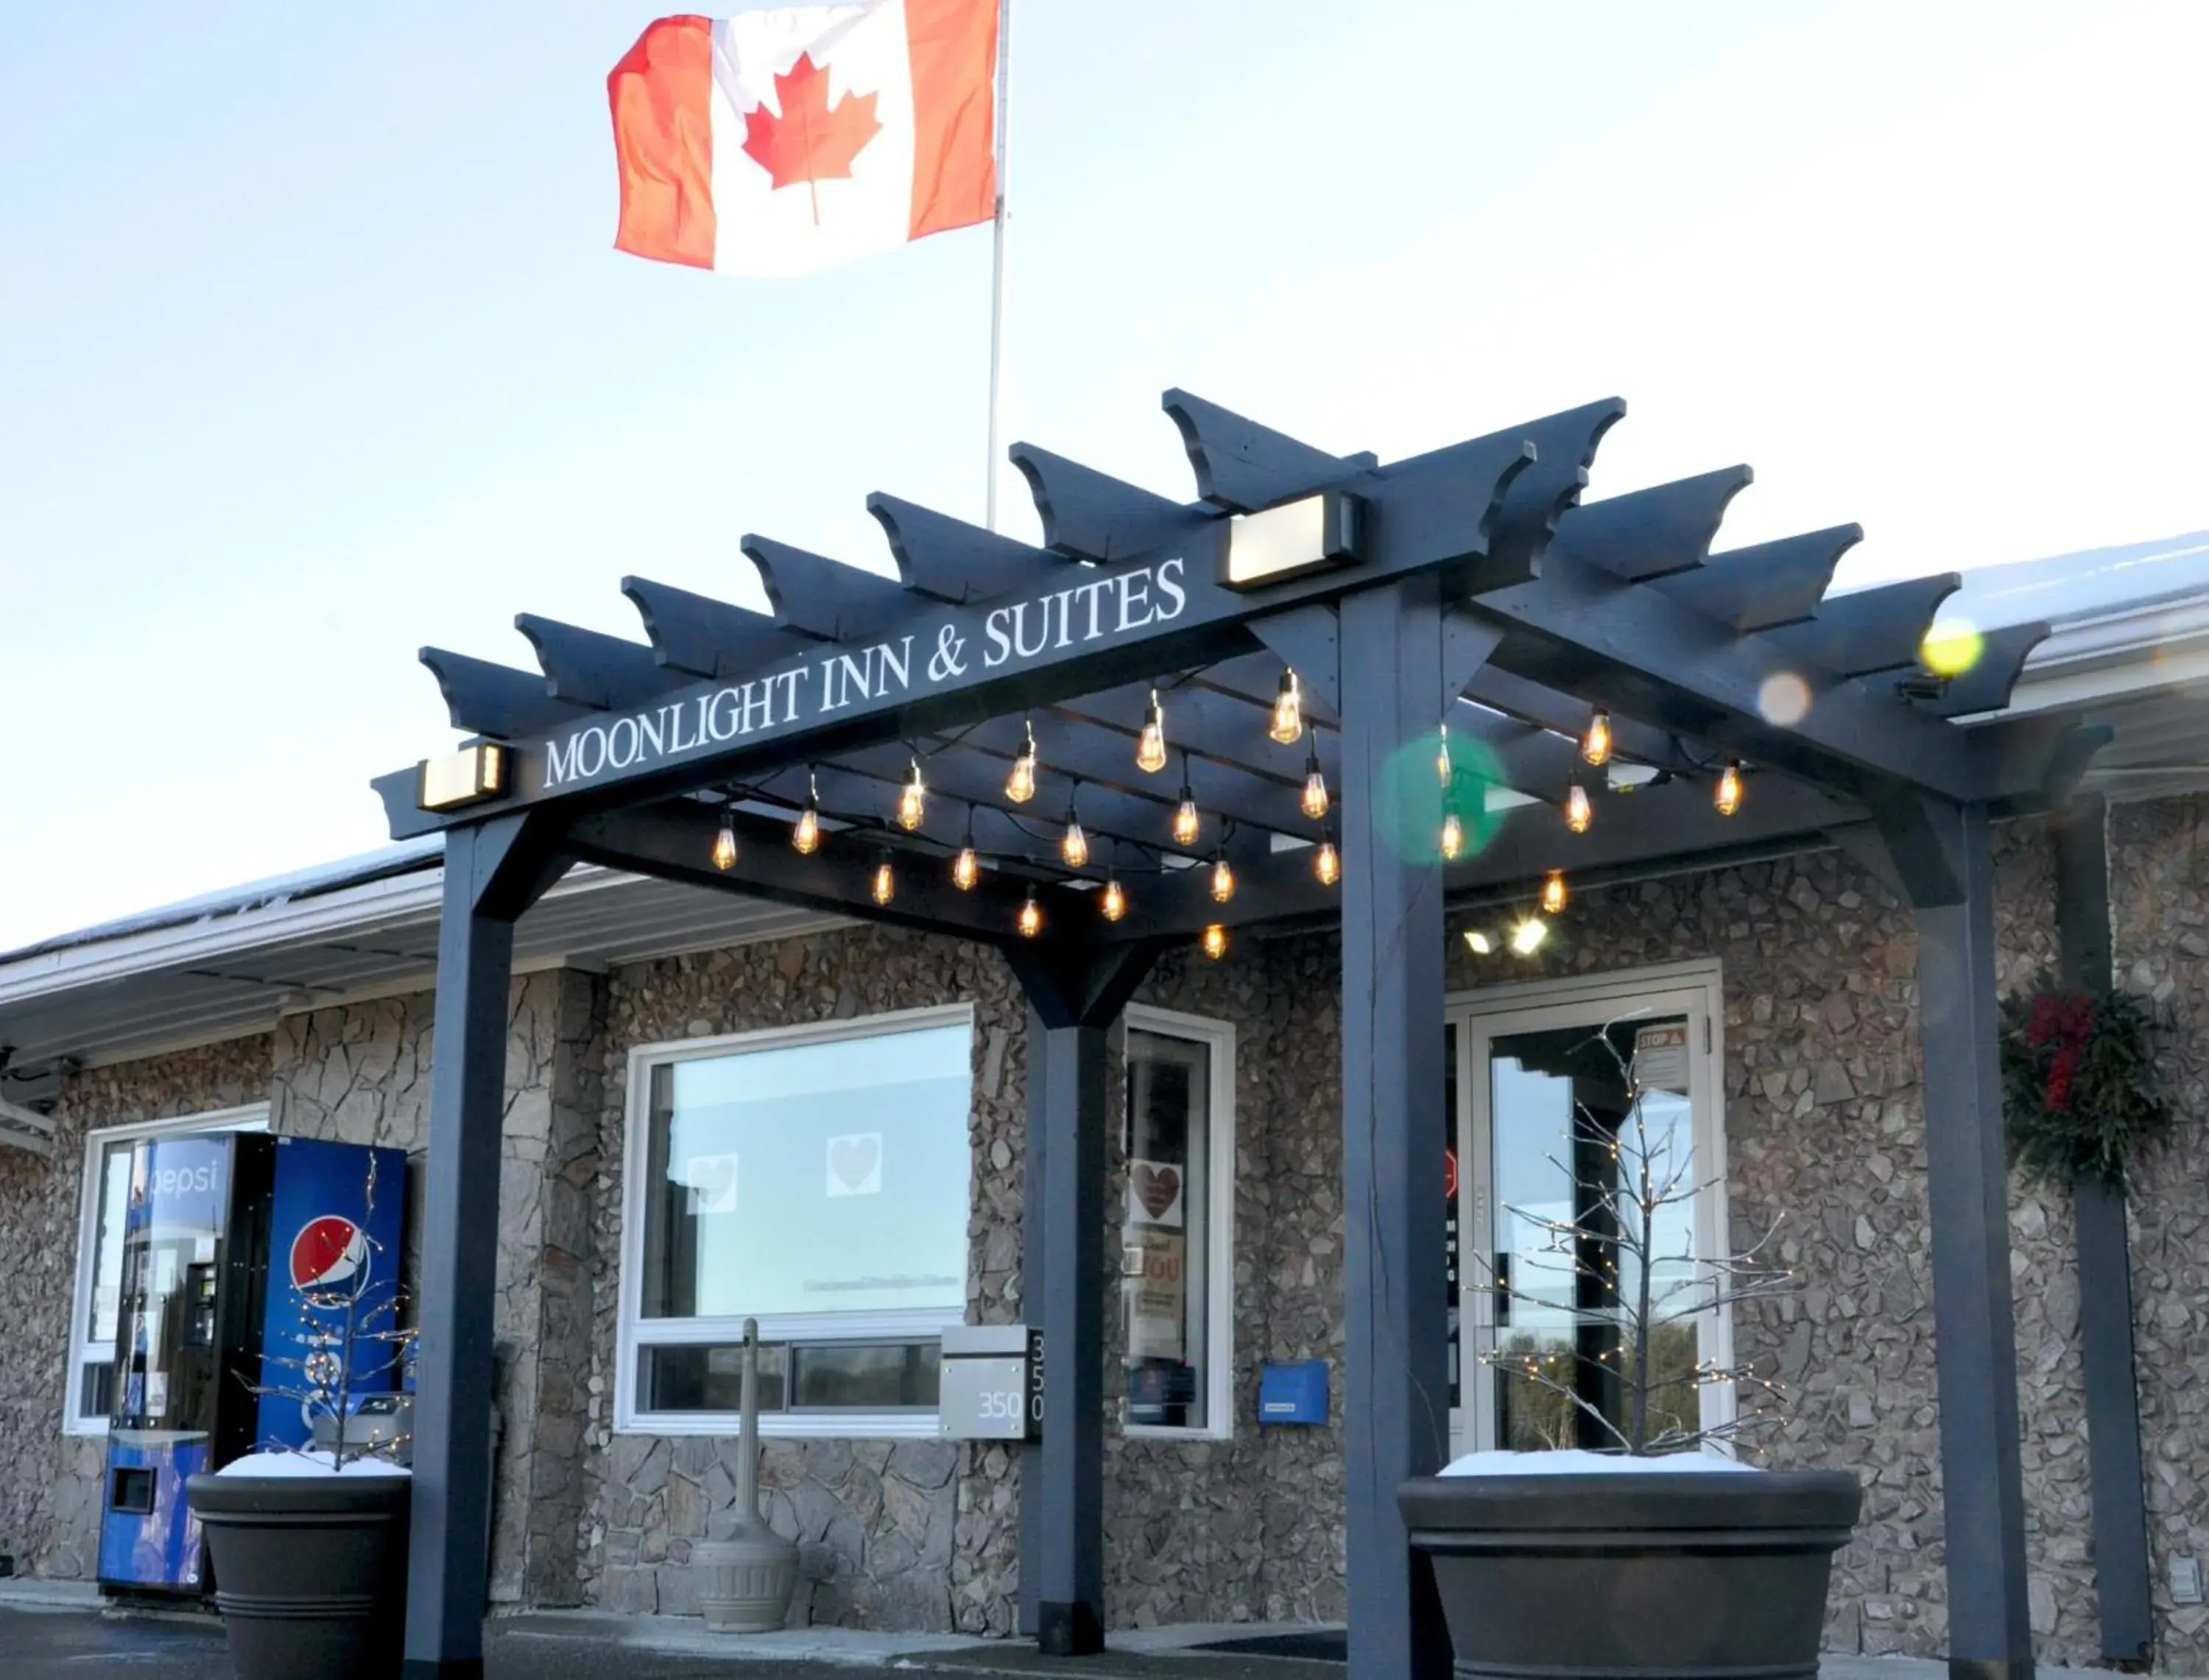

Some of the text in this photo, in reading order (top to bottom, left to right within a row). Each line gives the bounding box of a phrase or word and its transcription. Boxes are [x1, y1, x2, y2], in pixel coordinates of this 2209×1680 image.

[543, 558, 1186, 788] MOONLIGHT INN & SUITES
[978, 1391, 1021, 1418] 350
[1032, 1336, 1045, 1421] 350
